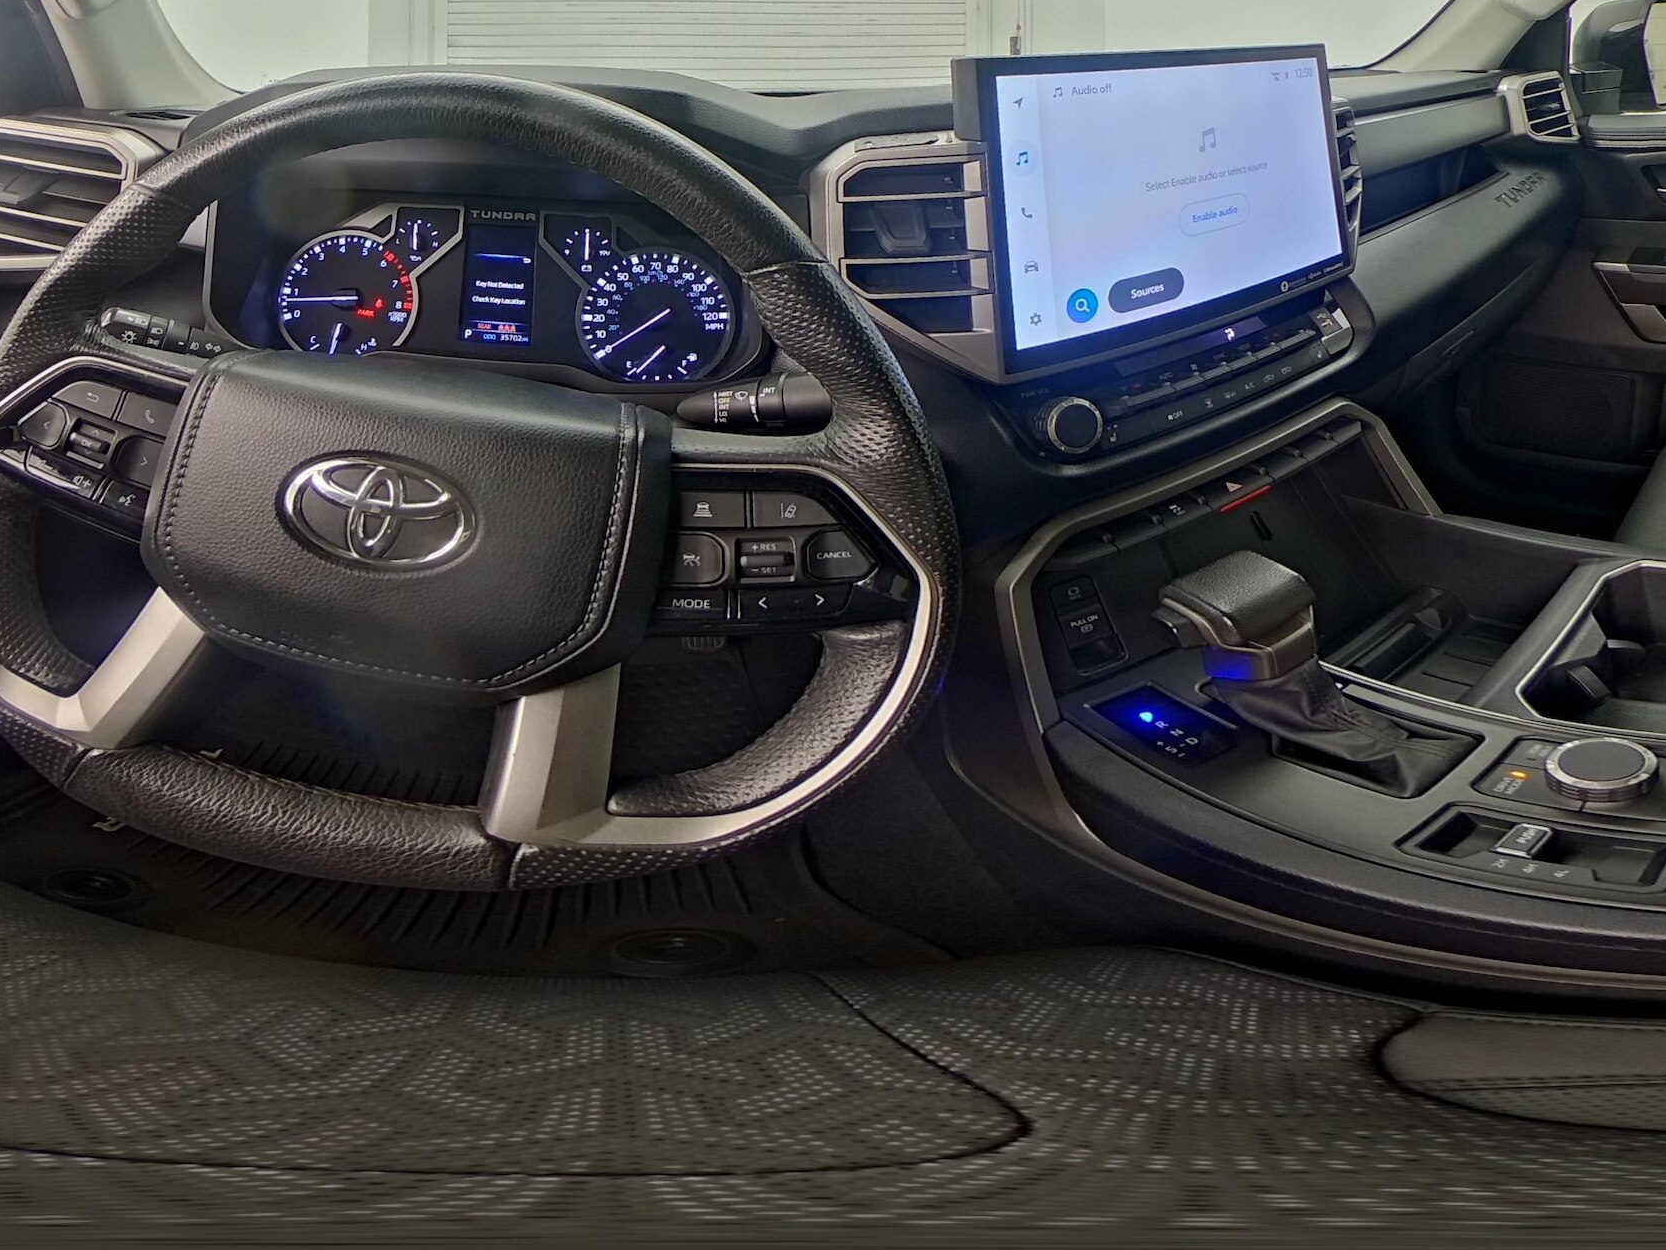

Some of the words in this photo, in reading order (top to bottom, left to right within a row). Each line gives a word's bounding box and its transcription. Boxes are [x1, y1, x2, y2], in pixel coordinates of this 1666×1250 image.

[1294, 68, 1314, 78] 12:50
[1071, 84, 1097, 95] Audio
[1099, 83, 1113, 93] off
[1145, 180, 1170, 192] Select
[1171, 174, 1197, 187] Enable
[1198, 171, 1217, 183] audio
[1218, 170, 1227, 178] or
[1227, 165, 1246, 177] select
[1247, 162, 1269, 173] source
[470, 210, 536, 221] TUNDRA
[1192, 210, 1217, 223] Enable
[1218, 206, 1239, 218] audio
[362, 248, 368, 256] 5
[318, 253, 325, 261] 3
[380, 260, 387, 268] 6
[650, 262, 661, 270] 70
[301, 268, 308, 276] 2
[632, 265, 644, 273] 60
[667, 265, 679, 273] 80
[617, 273, 629, 281] 50
[683, 272, 695, 281] 90
[392, 280, 398, 288] 7
[476, 280, 487, 288] Key
[498, 282, 524, 290] Detected
[604, 283, 616, 292] 40
[691, 284, 707, 292] 100
[294, 288, 299, 296] 1
[1130, 283, 1165, 299] Sources
[472, 295, 489, 303] Check
[490, 297, 501, 305] Key
[596, 298, 609, 307] 30
[700, 297, 715, 305] 110
[395, 301, 402, 309] 8
[294, 309, 301, 318] 0
[702, 312, 719, 320] 120
[593, 314, 605, 323] 20
[705, 323, 724, 331] MPH
[464, 329, 472, 339] P
[595, 330, 606, 339] 10
[718, 397, 731, 405] OFF
[816, 550, 852, 560] CANCEL
[672, 598, 711, 609] MODE
[1070, 618, 1087, 628] PULL
[1087, 613, 1099, 622] ON
[1155, 721, 1169, 729] R
[1170, 728, 1184, 737] N
[1185, 737, 1199, 745] D
[1516, 829, 1537, 844] PUSH
[1492, 858, 1509, 868] 2H
